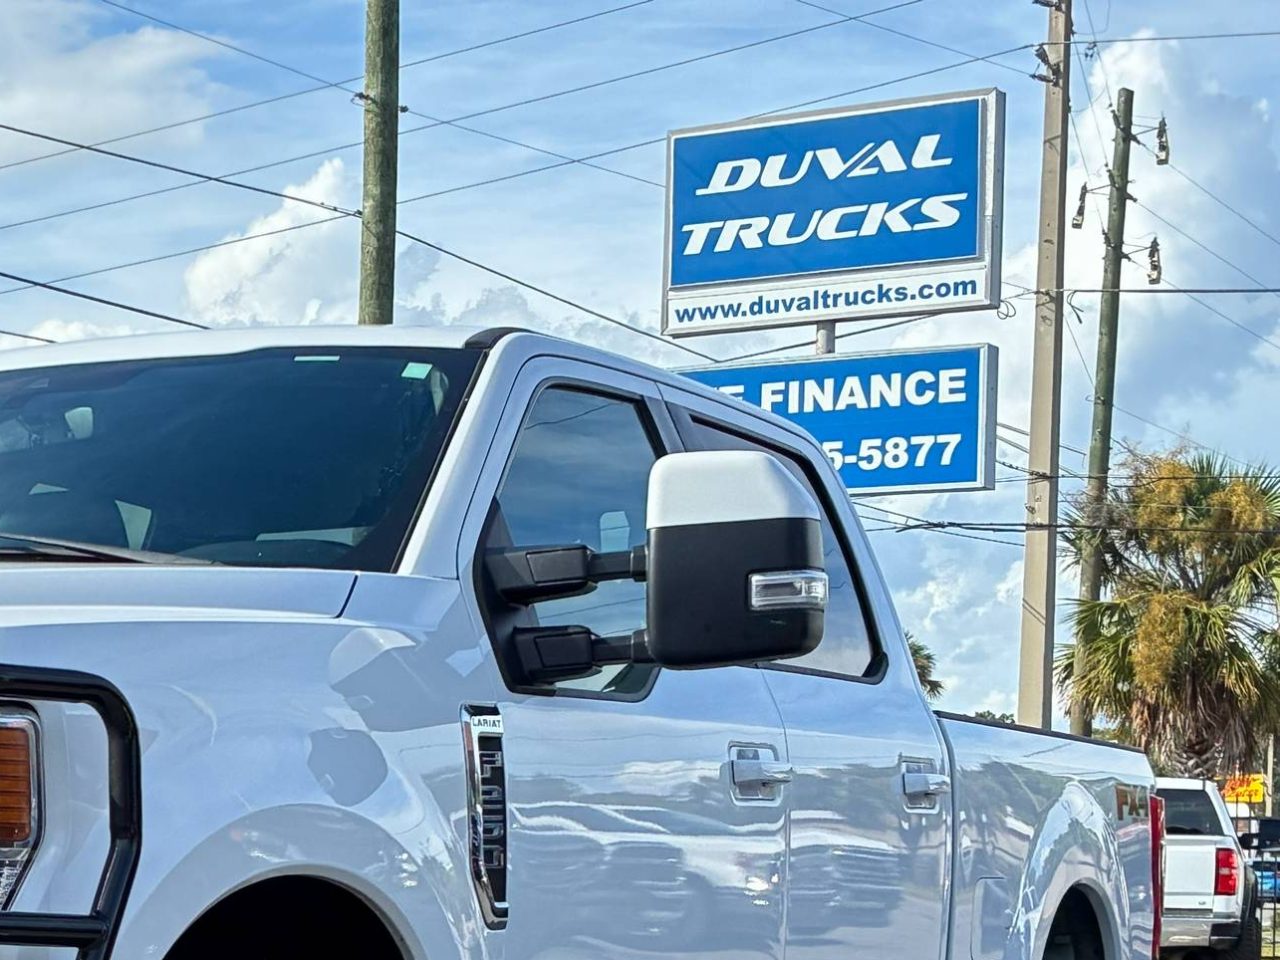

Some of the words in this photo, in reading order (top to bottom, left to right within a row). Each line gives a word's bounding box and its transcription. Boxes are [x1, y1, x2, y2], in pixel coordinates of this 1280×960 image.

[695, 133, 953, 196] DUVAL
[681, 192, 968, 256] TRUCKS
[675, 277, 978, 323] www.duvaltrucks.com
[761, 367, 967, 414] FINANCE
[472, 717, 501, 728] LARIAT
